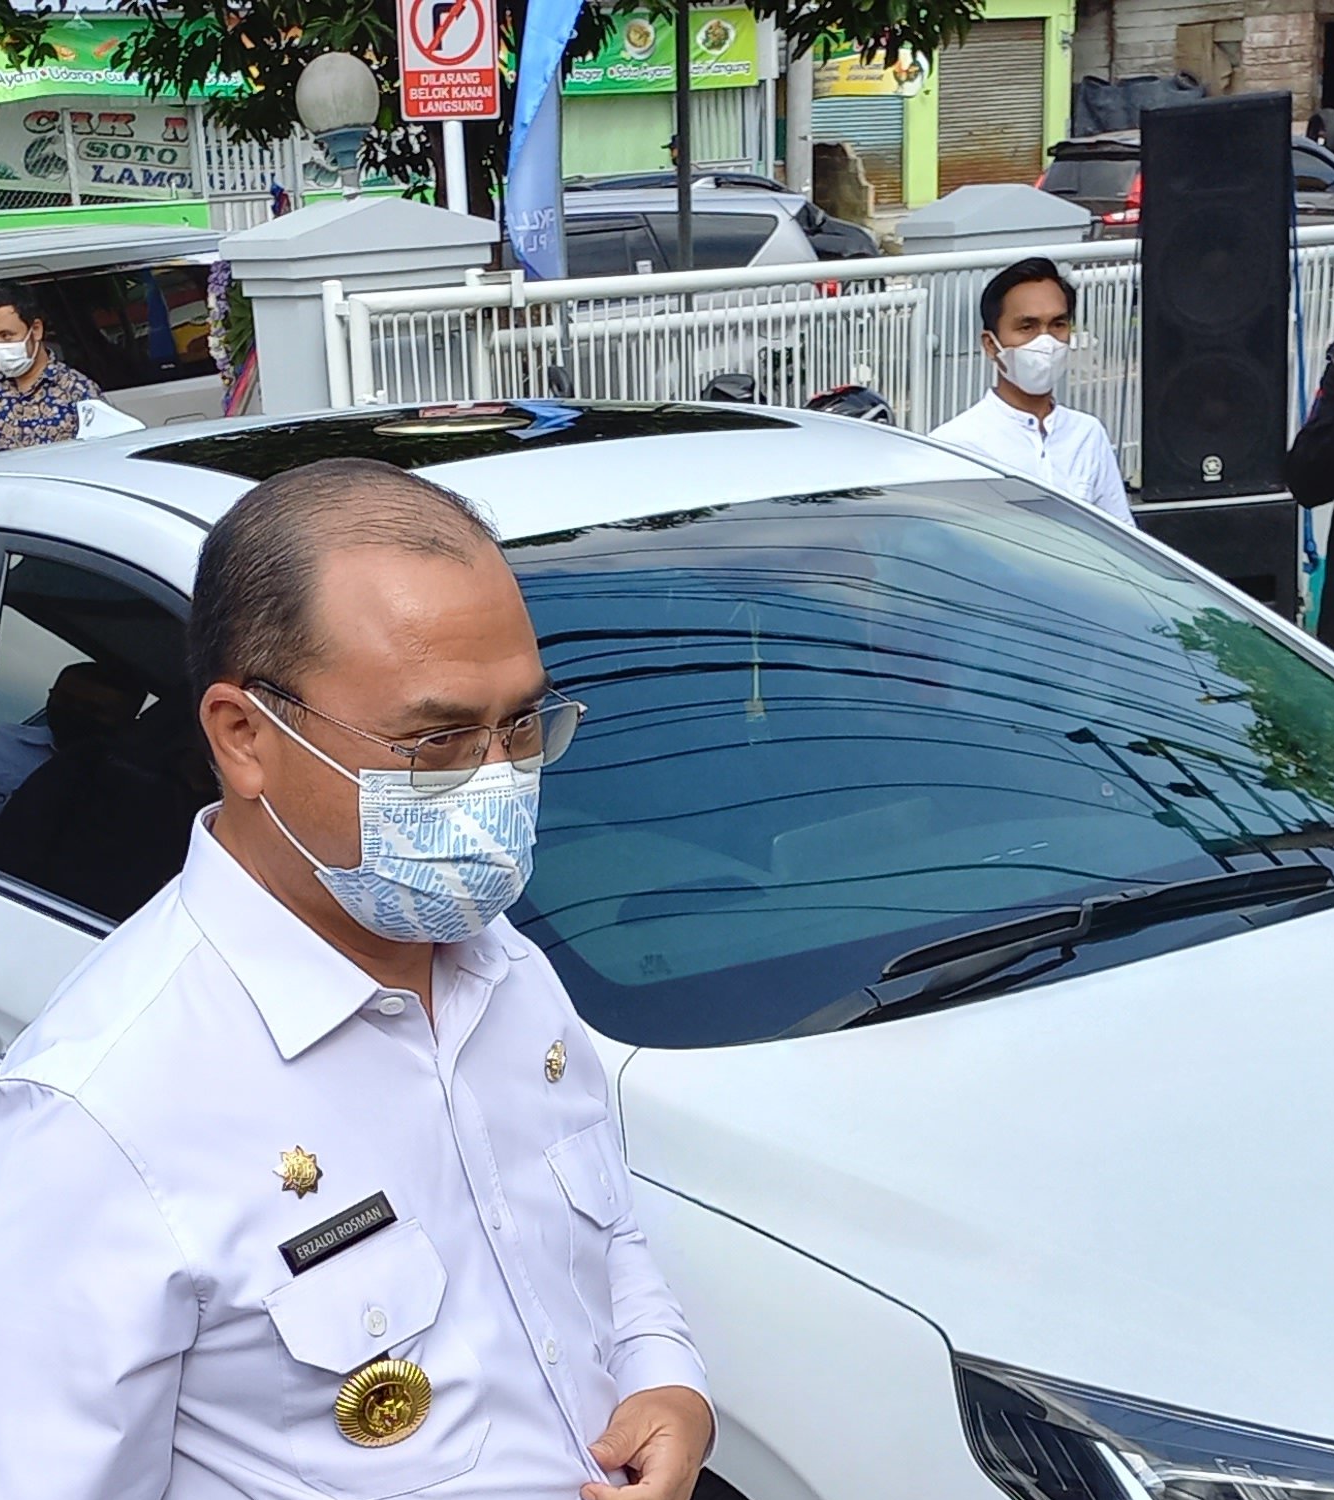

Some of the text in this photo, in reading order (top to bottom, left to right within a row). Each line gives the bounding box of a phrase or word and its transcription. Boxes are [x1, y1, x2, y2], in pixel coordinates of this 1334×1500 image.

[48, 68, 94, 83] Udang
[420, 72, 480, 86] DILARANG
[409, 85, 493, 99] BELOK KANAN
[419, 100, 484, 113] LANGSUNG
[84, 141, 178, 165] SOTO
[295, 1206, 383, 1260] ERZALDI ROSMAN
